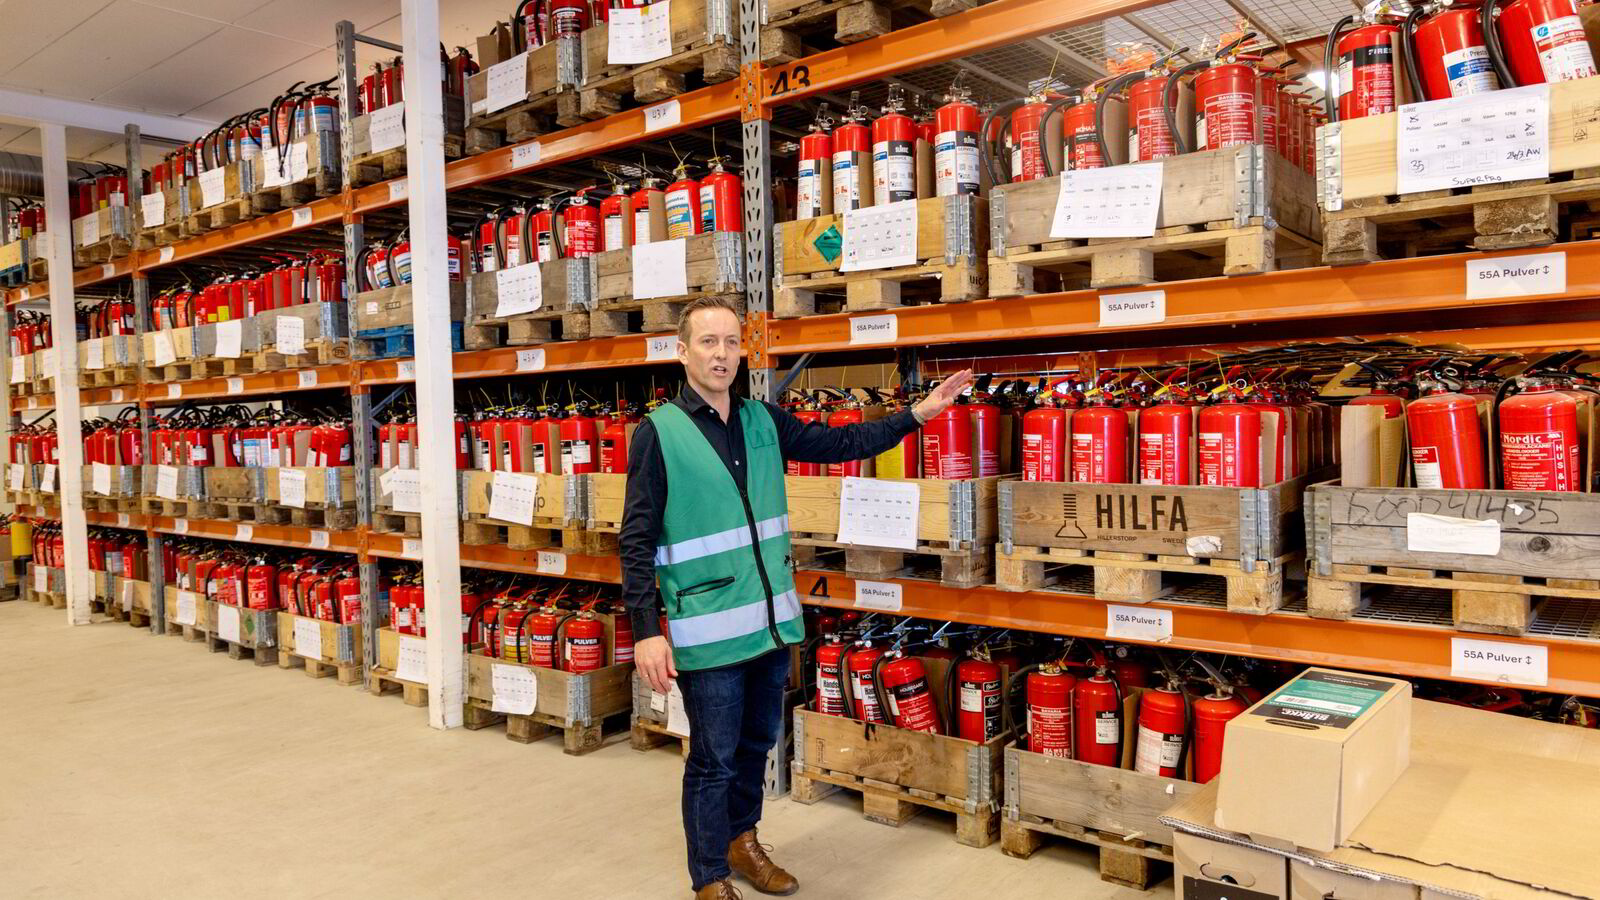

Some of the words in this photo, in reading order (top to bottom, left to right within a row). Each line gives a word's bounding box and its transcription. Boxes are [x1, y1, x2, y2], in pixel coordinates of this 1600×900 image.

[770, 65, 811, 97] 43
[1479, 270, 1500, 279] 55A
[1503, 268, 1540, 277] Pulver
[1503, 434, 1542, 444] Nordic
[1096, 494, 1188, 531] HILFA
[810, 576, 831, 598] 4
[873, 589, 890, 597] Pulver
[1116, 614, 1130, 622] 55A
[1131, 616, 1156, 625] Pulver
[1464, 650, 1484, 659] 55A
[1487, 652, 1523, 663] Pulver
